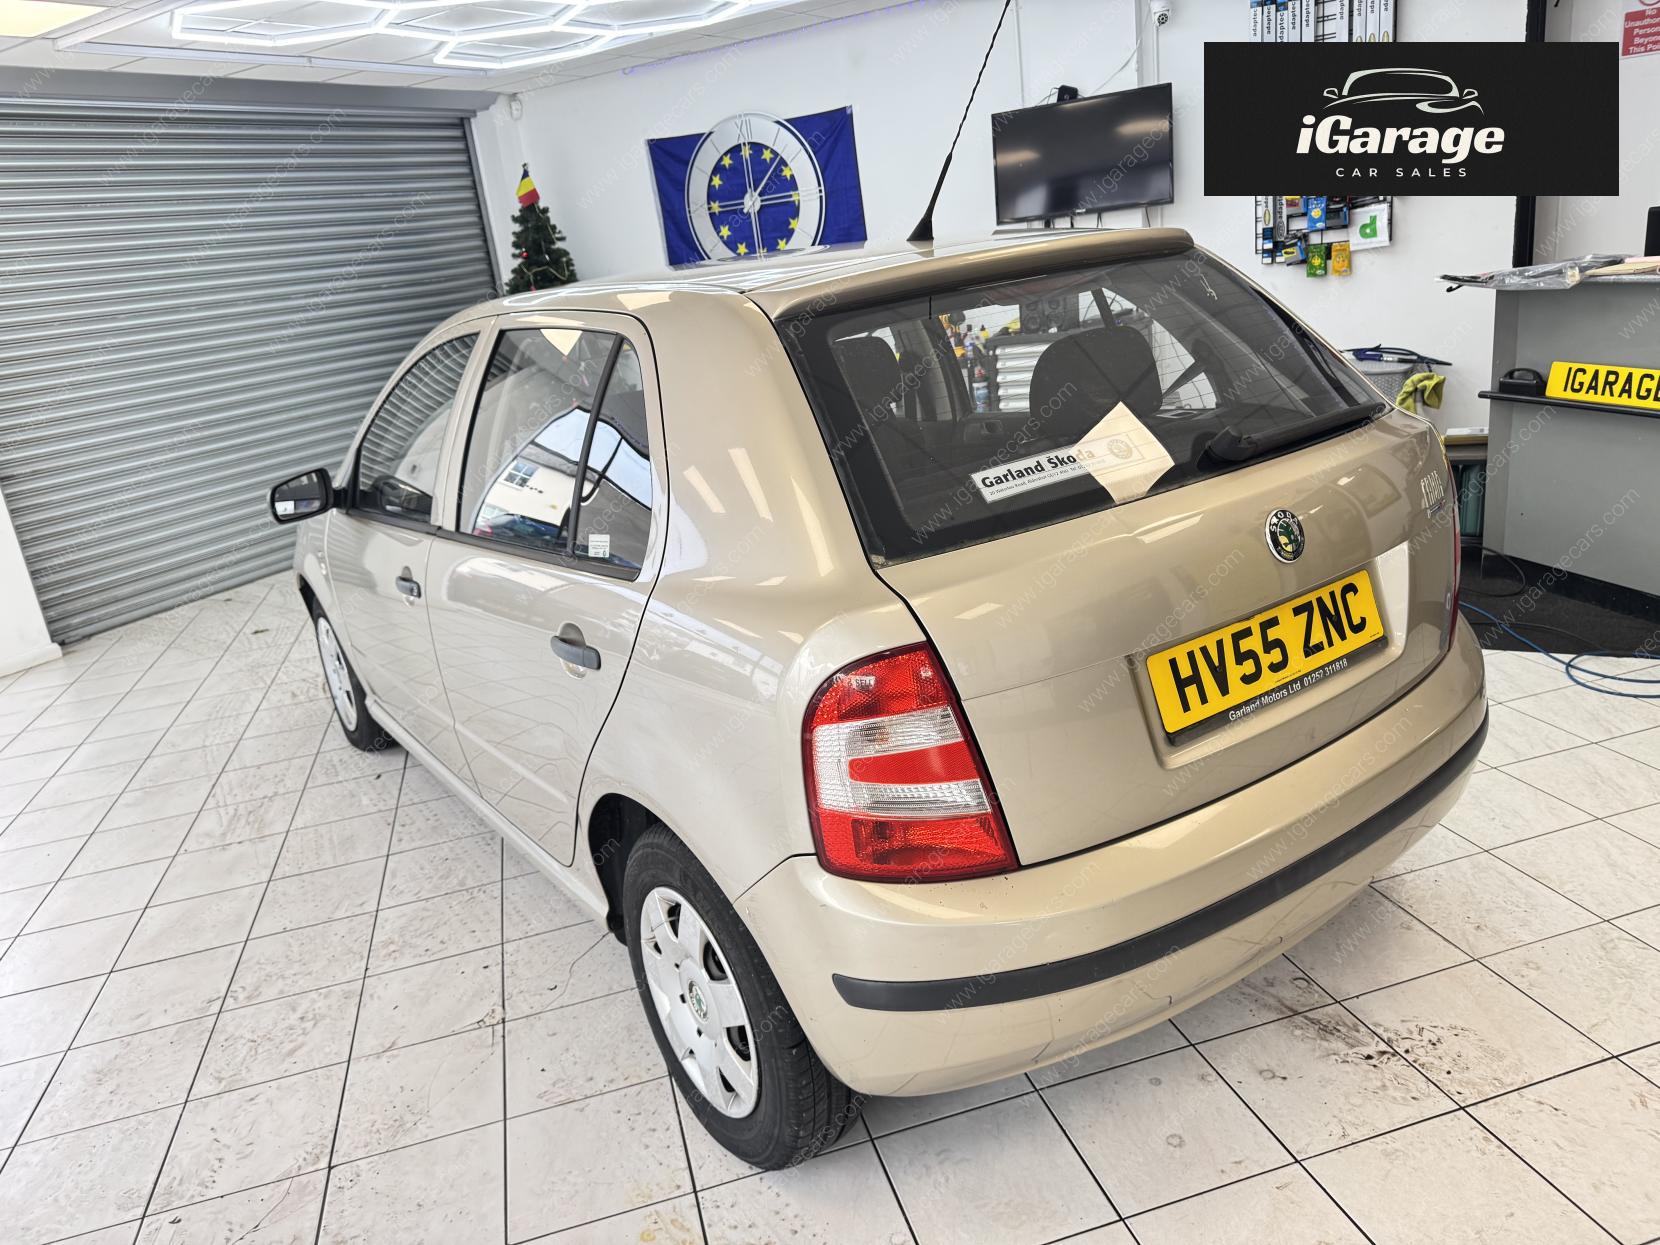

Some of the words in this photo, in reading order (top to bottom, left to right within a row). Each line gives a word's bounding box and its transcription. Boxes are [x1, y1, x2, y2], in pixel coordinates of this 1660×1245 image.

[981, 459, 1046, 489] Garland
[1168, 615, 1289, 714] HV55
[1292, 582, 1367, 659] ZNC
[1228, 701, 1261, 721] Garland
[1261, 687, 1288, 707] Motors
[1289, 681, 1301, 694] Ltd
[1325, 658, 1348, 677] 311818
